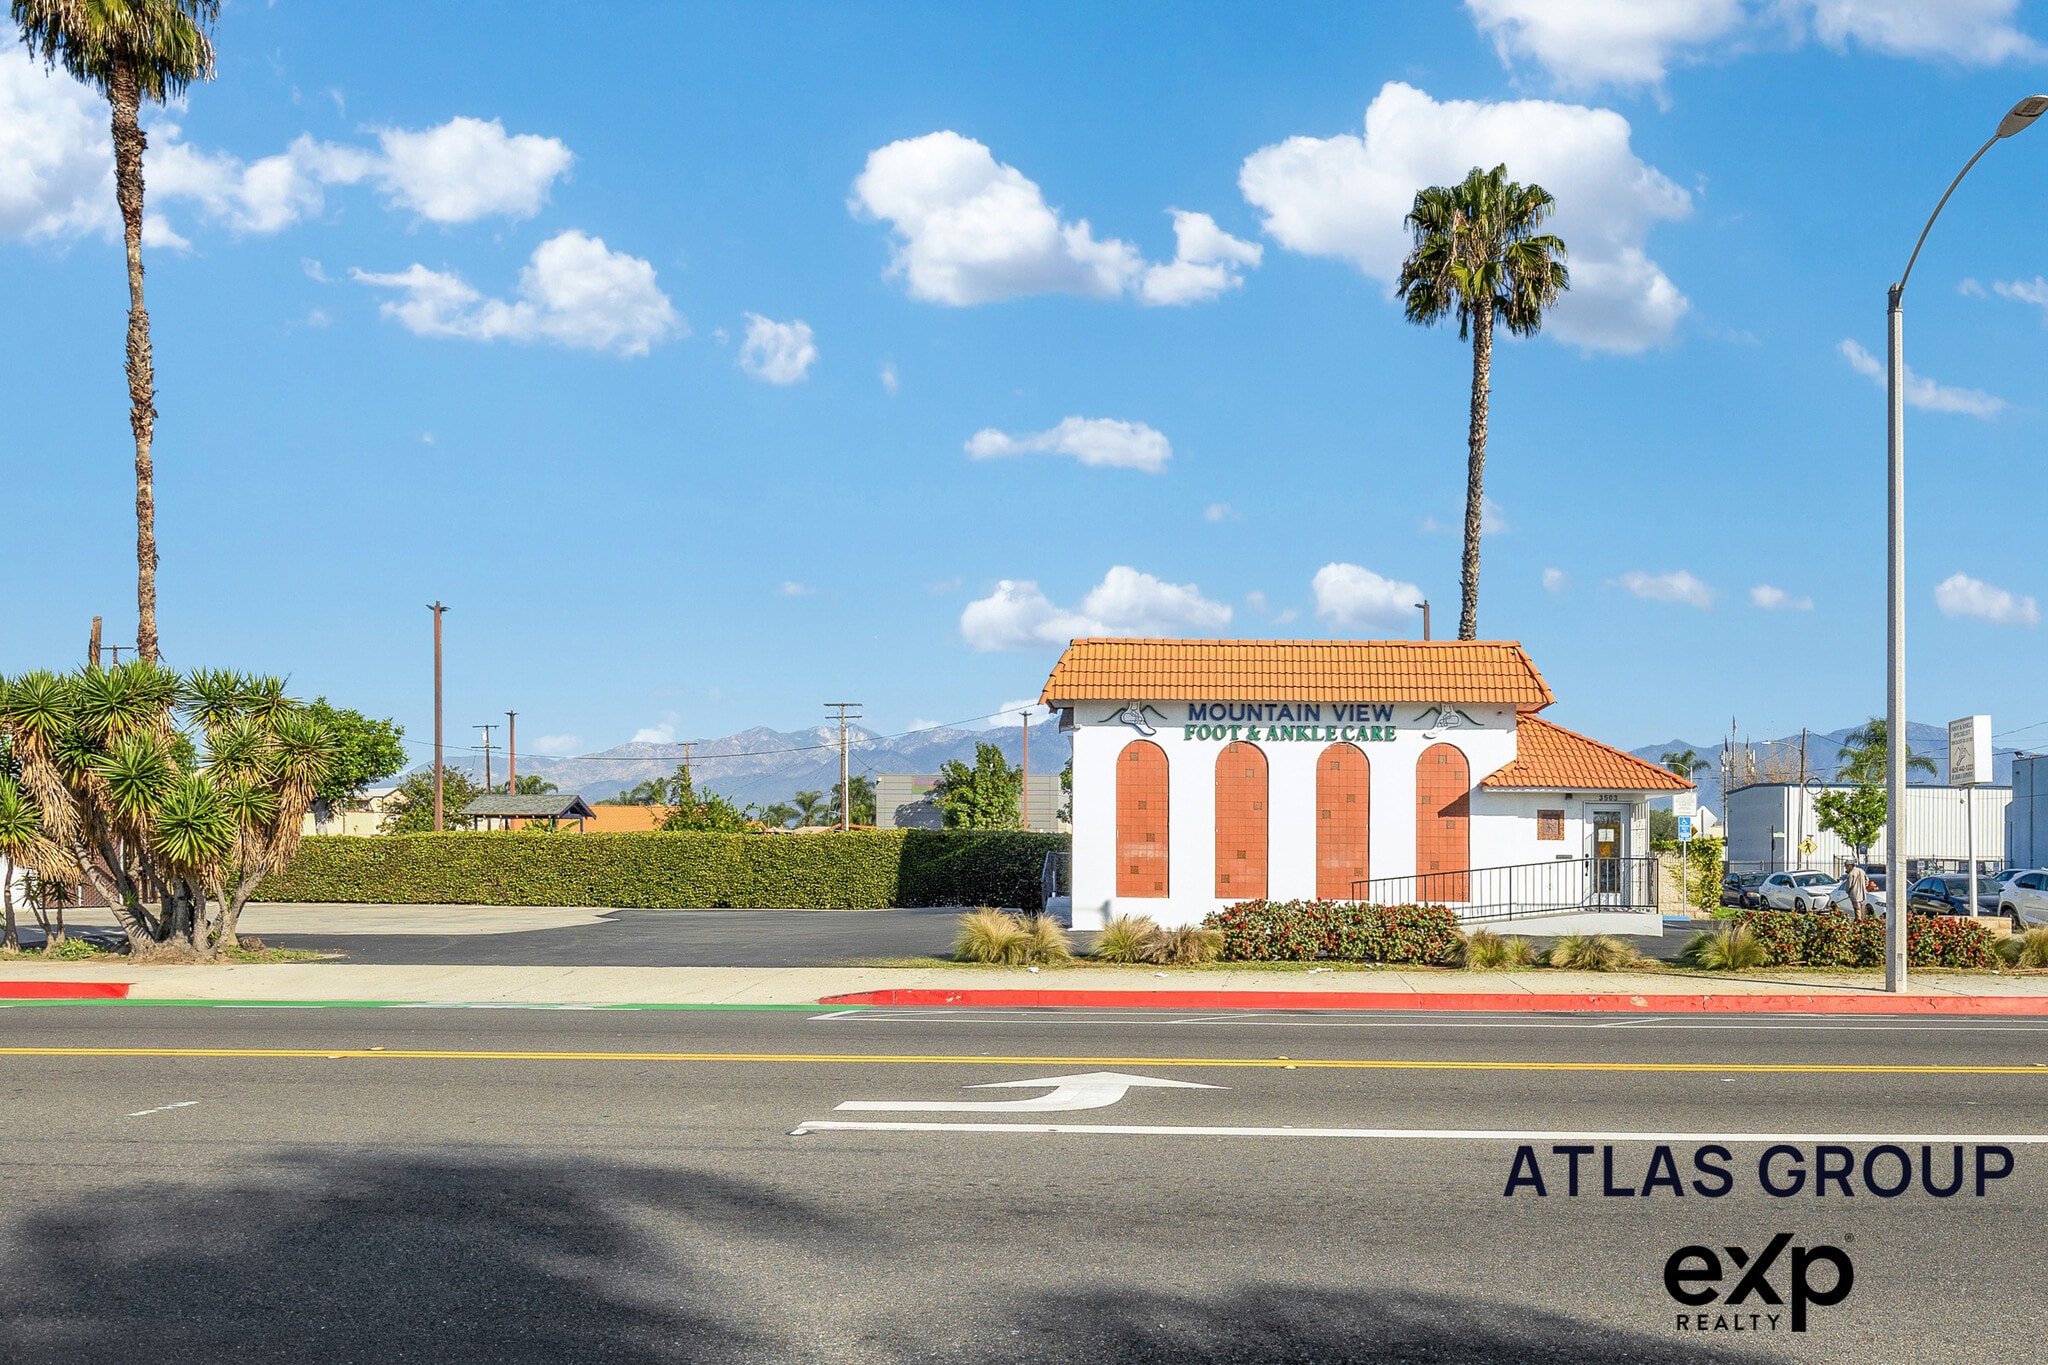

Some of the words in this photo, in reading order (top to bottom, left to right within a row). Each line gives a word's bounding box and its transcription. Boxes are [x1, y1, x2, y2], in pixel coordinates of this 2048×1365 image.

[1188, 703, 1320, 722] MOUNTAIN
[1333, 703, 1395, 722] VIEW
[1184, 724, 1242, 741] FOOT
[1247, 724, 1262, 741] &
[1265, 725, 1338, 742] ANKLE
[1342, 725, 1397, 742] CARE
